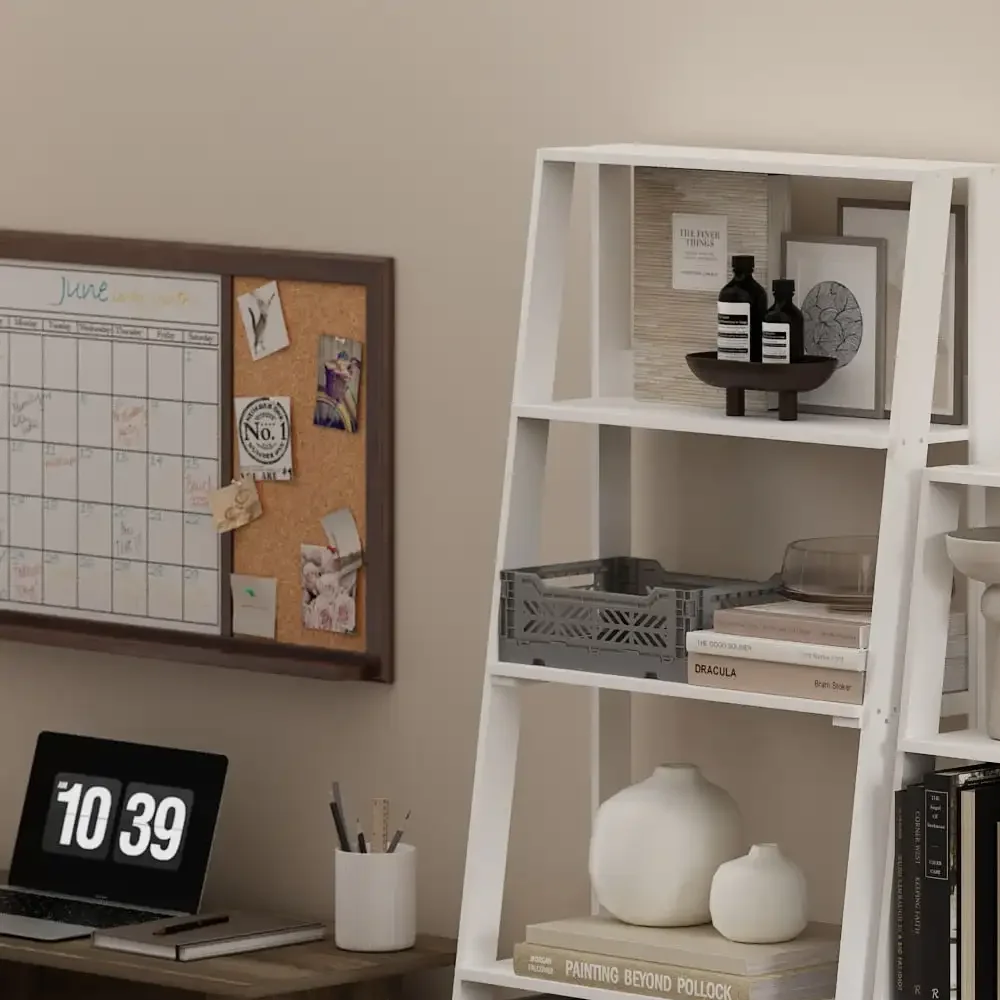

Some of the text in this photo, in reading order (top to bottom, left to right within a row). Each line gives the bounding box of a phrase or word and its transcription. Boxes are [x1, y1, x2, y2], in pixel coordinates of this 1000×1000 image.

[48, 276, 109, 306] June
[243, 421, 287, 441] No. 1
[695, 663, 737, 678] DRACULA
[814, 679, 852, 692] Bram Stoker
[57, 782, 186, 861] 10 39
[565, 958, 619, 985] PAINTING
[624, 968, 672, 994] BEYOND
